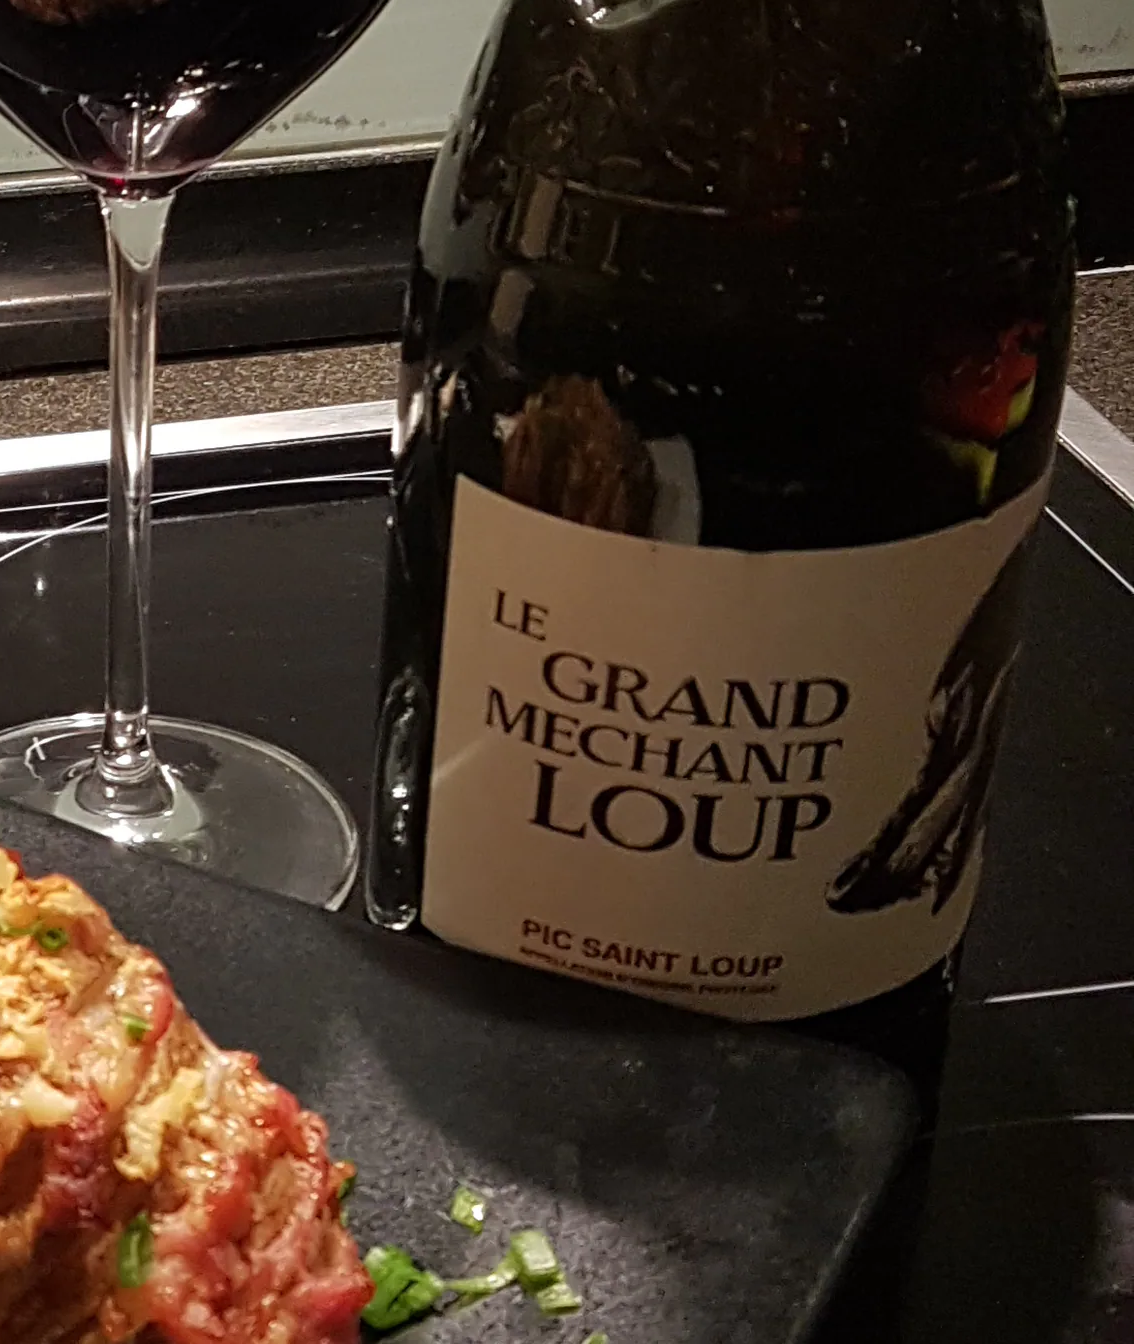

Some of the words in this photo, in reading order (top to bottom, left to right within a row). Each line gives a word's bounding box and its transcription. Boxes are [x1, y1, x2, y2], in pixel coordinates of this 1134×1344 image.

[492, 588, 550, 642] LE
[541, 651, 850, 730] GRAND
[484, 686, 844, 785] MECHANT
[528, 759, 832, 862] LOUP
[522, 918, 573, 952] PIC
[582, 937, 682, 974] SAINT
[690, 955, 784, 979] LOUP
